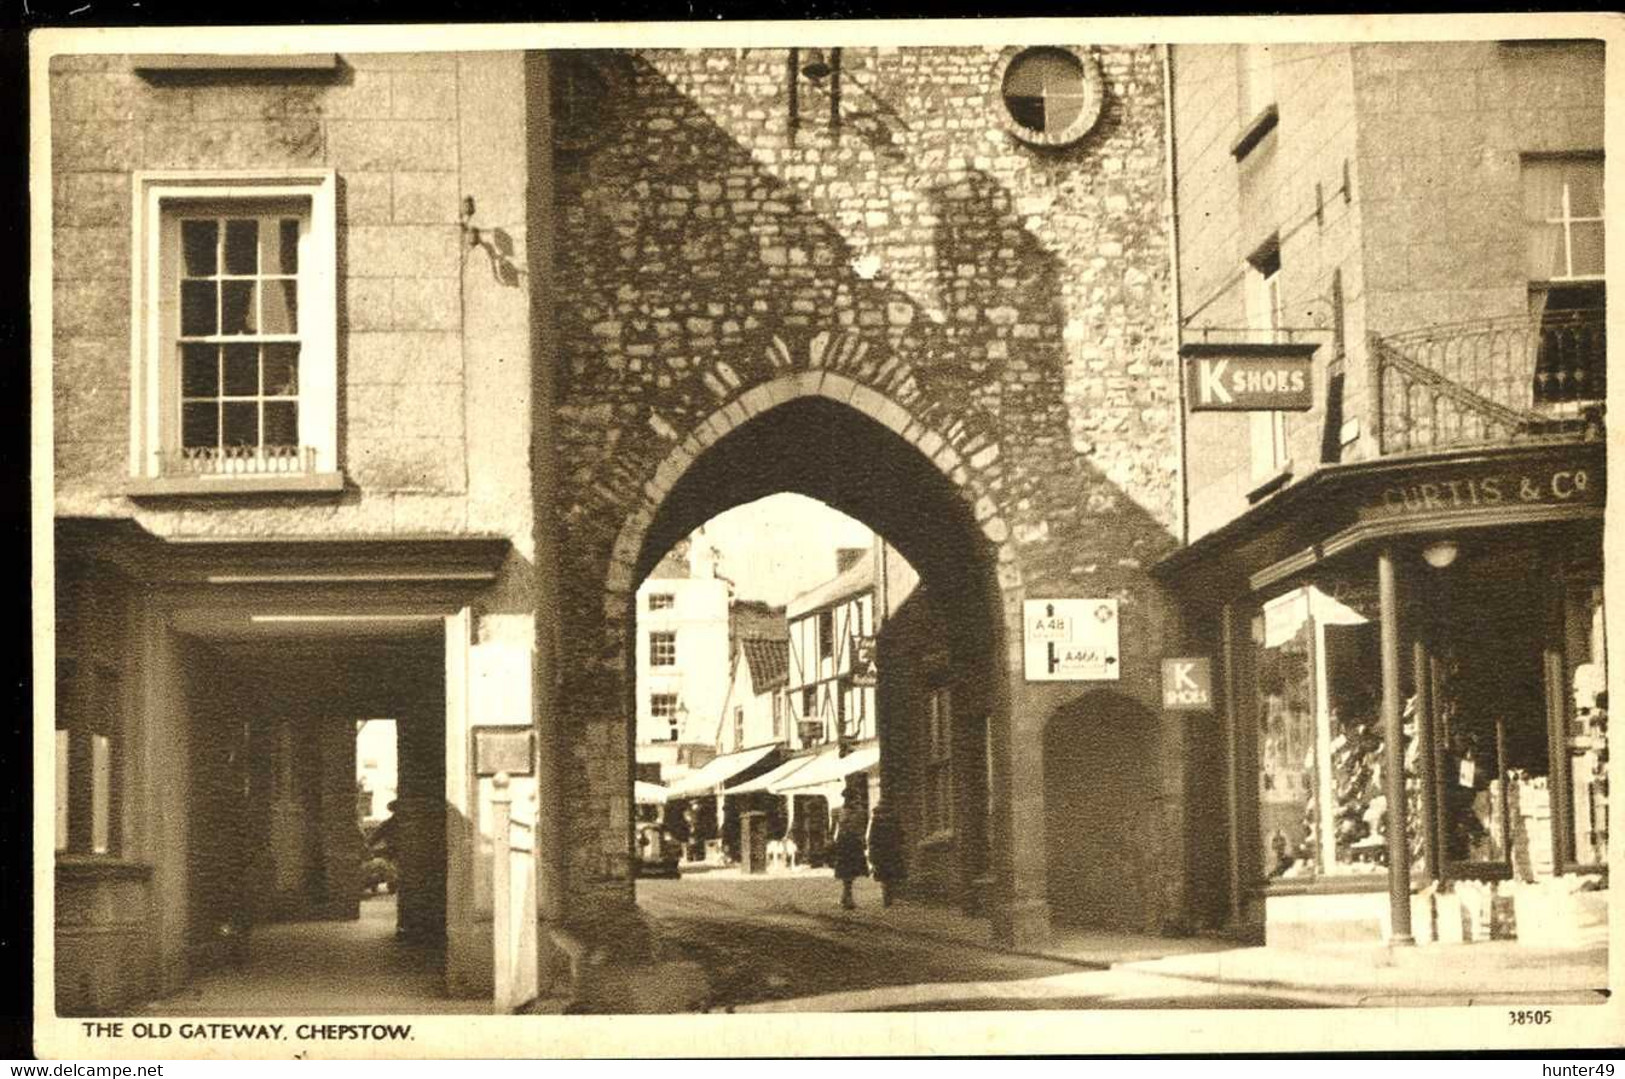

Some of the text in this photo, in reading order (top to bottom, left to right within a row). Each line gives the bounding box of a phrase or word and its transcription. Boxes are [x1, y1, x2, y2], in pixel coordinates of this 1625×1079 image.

[1200, 359, 1305, 403] K SHOES
[1382, 477, 1501, 512] CURTIS
[1519, 476, 1540, 501] &
[1174, 663, 1198, 689] K
[1508, 1010, 1552, 1025] 38505
[82, 1022, 123, 1038] THE
[132, 1022, 172, 1039] OLD
[296, 1024, 415, 1041] CHEPSTOW.
